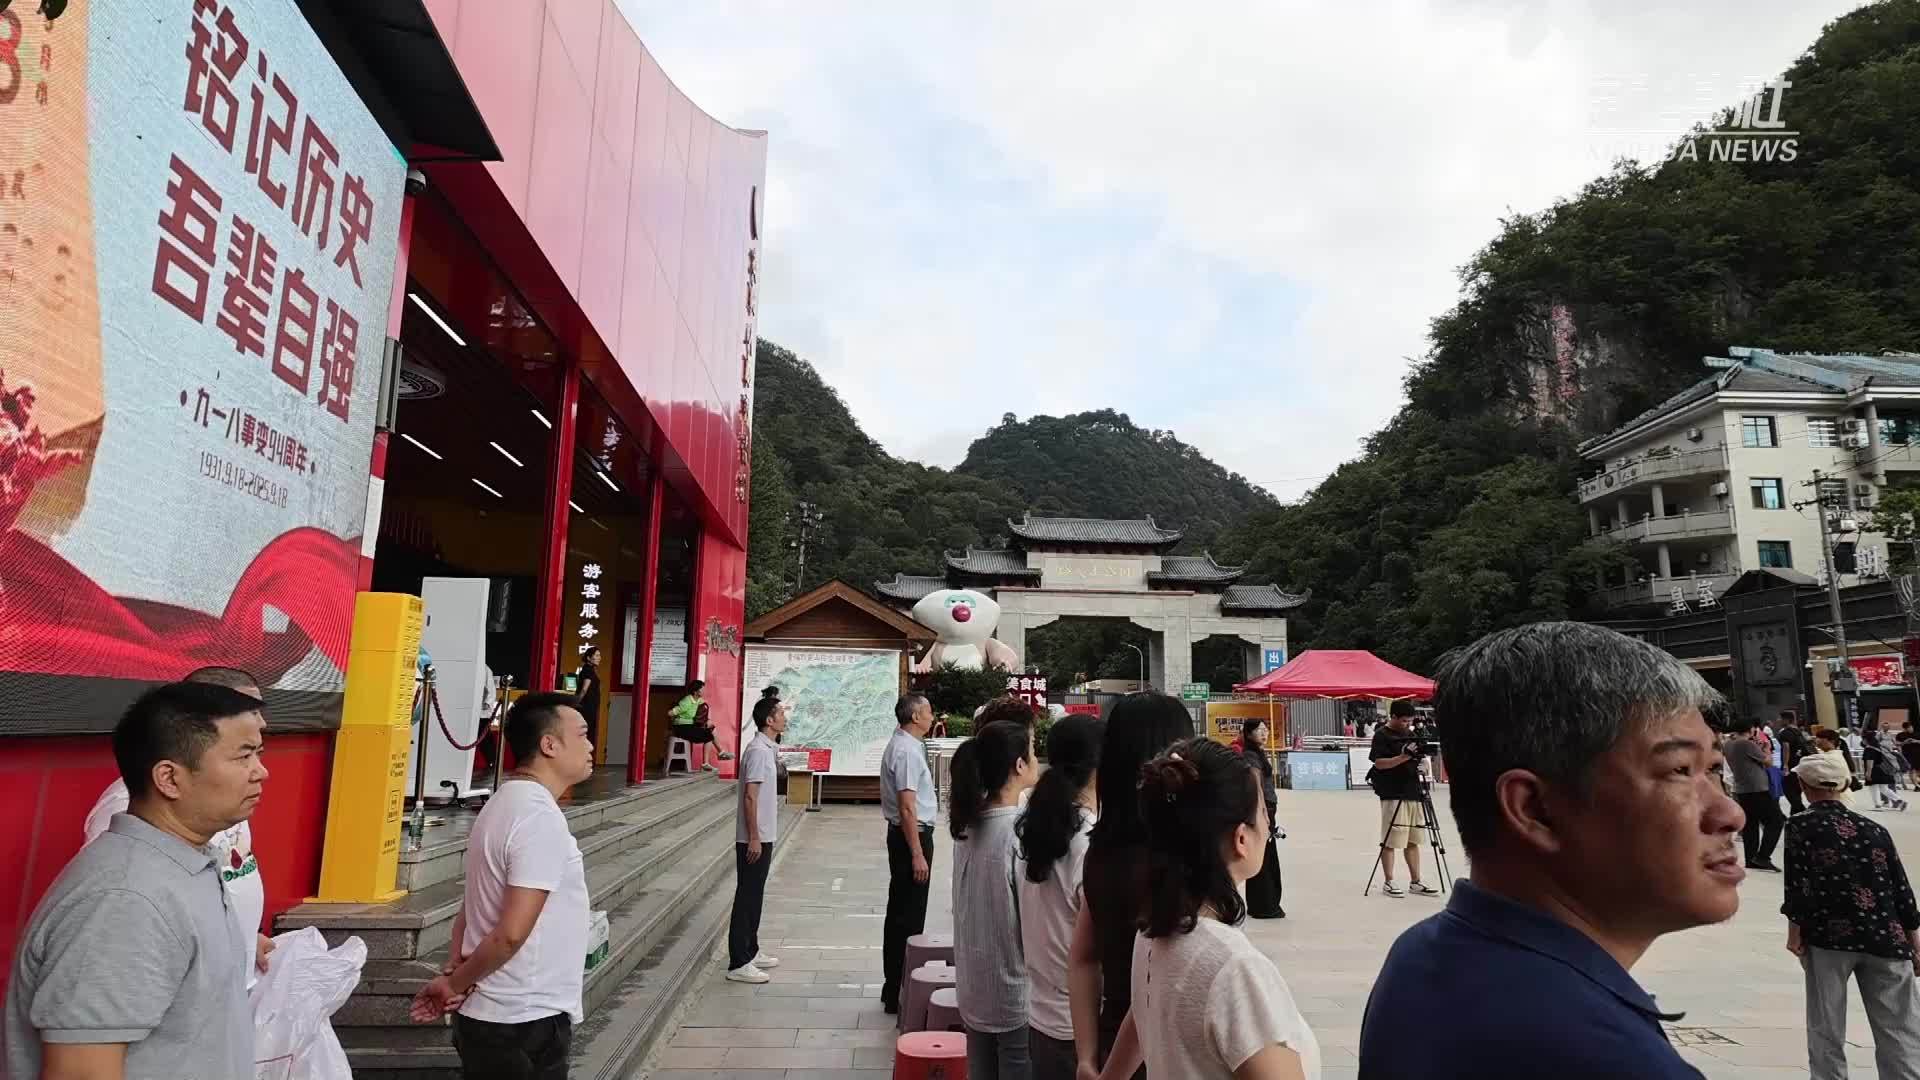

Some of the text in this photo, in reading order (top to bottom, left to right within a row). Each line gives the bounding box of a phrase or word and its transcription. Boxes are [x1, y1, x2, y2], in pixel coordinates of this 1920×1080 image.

[184, 0, 374, 289] 铭记历史
[152, 152, 359, 424] 吾辈自强
[1006, 676, 1048, 692] 美食城
